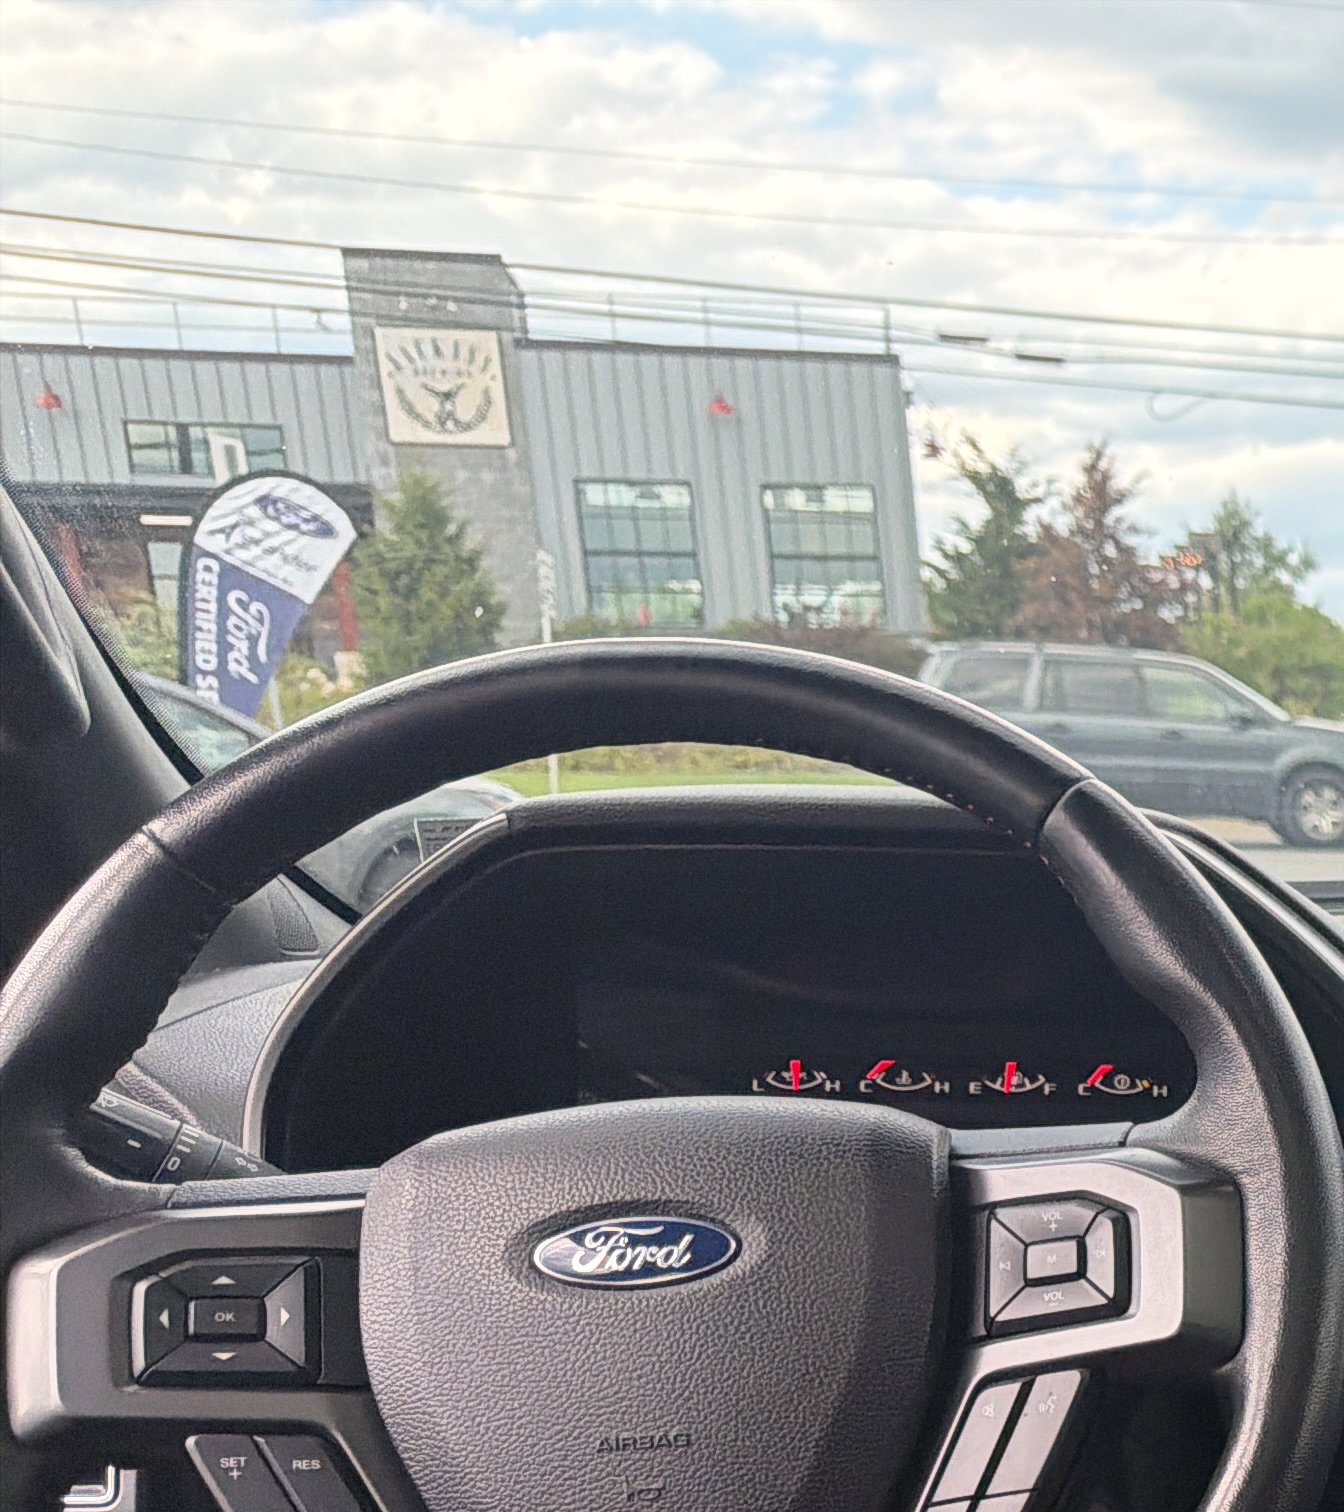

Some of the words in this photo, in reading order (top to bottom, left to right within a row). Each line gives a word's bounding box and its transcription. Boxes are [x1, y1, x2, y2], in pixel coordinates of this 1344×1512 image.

[195, 558, 220, 671] CERTIFIED
[227, 589, 270, 684] Ford
[825, 1080, 841, 1093] H
[859, 1080, 872, 1093] C
[934, 1081, 950, 1094] H
[969, 1081, 982, 1095] E
[1044, 1082, 1057, 1096] F
[1078, 1083, 1091, 1097] C
[1152, 1084, 1168, 1098] H
[1042, 1211, 1063, 1222] VOL
[572, 1226, 694, 1272] Ford
[1043, 1291, 1064, 1302] VOL
[214, 1311, 236, 1323] OK
[598, 1433, 692, 1451] AIRBAG
[220, 1456, 247, 1468] SET
[292, 1459, 321, 1471] RES
